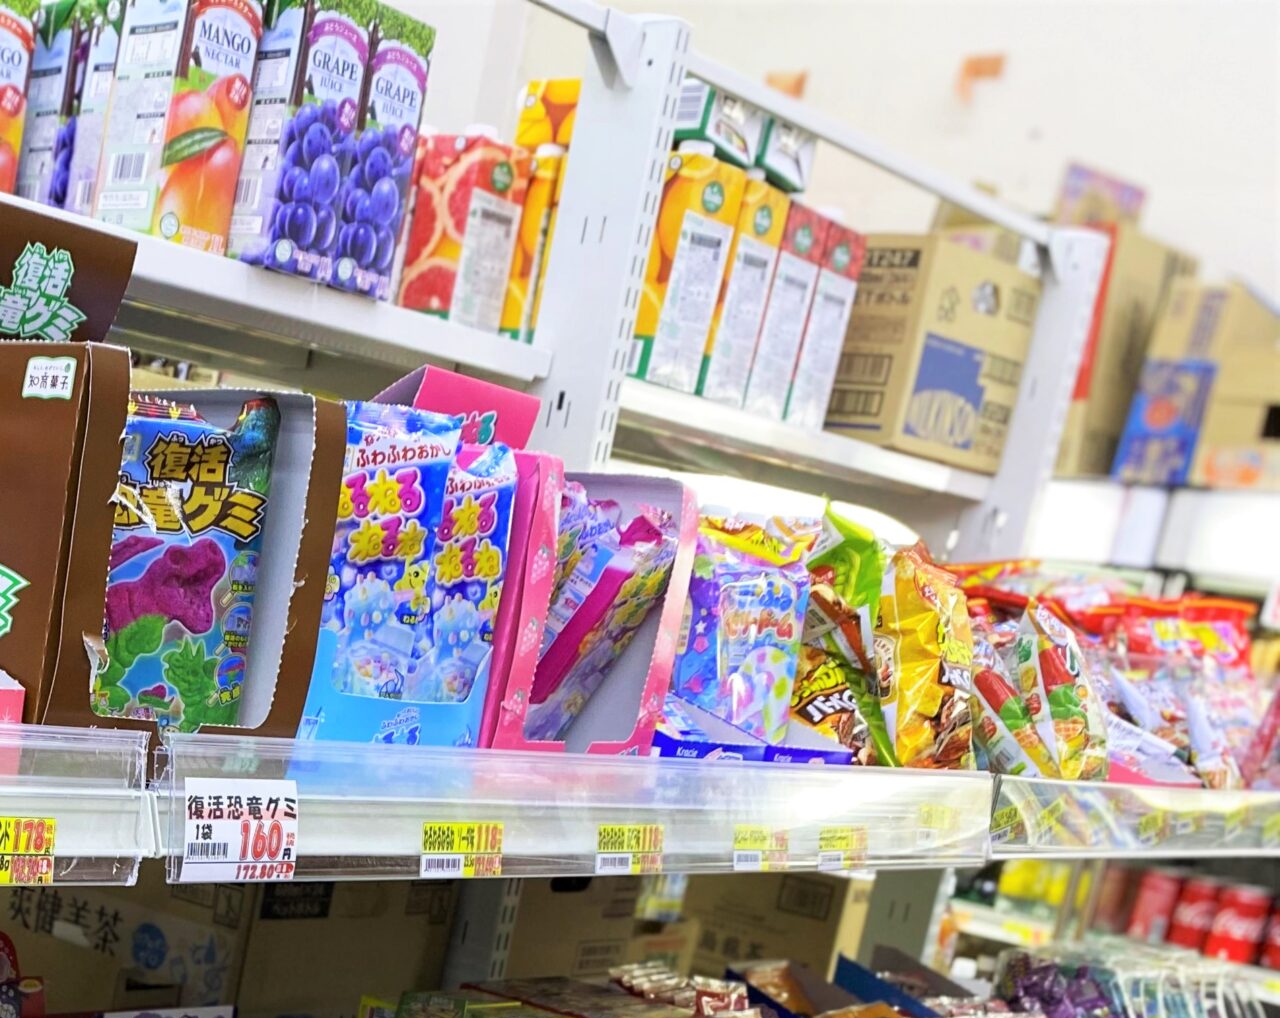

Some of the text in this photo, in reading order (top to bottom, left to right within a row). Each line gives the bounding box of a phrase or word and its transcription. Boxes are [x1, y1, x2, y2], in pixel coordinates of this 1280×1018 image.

[199, 19, 252, 55] MANGO
[203, 46, 241, 70] NECTAR
[312, 48, 359, 81] GRAPE
[319, 73, 345, 94] JUICE
[374, 76, 418, 108] GRAPE
[381, 99, 405, 120] JUICE
[27, 371, 69, 391] 知育菓子
[154, 444, 228, 482] 復活
[356, 444, 451, 469] ふわふわおかし
[347, 518, 426, 566] ねるね
[187, 795, 297, 820] 復活恐竜グミ
[12, 818, 47, 853] 178
[195, 823, 213, 840] 1袋
[238, 820, 283, 861] 160
[475, 823, 499, 851] 118
[235, 864, 275, 880] 172.80
